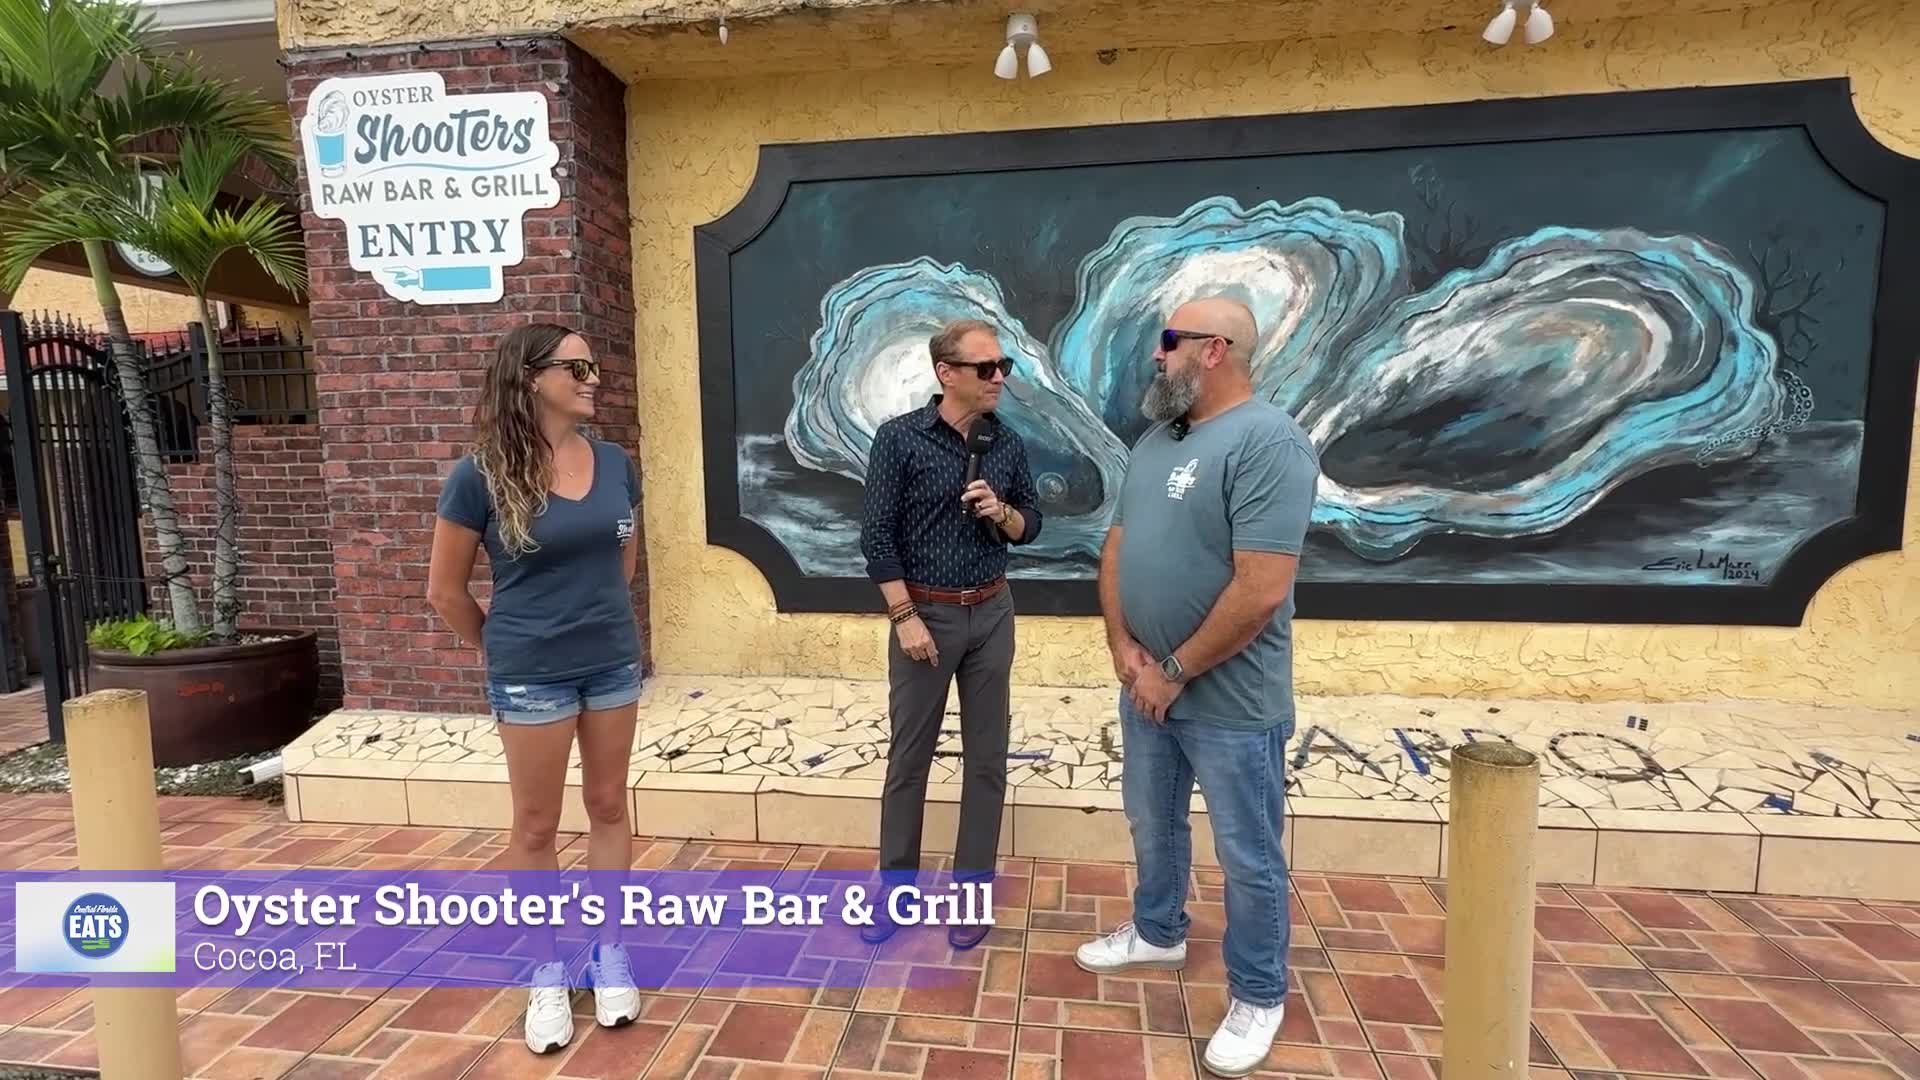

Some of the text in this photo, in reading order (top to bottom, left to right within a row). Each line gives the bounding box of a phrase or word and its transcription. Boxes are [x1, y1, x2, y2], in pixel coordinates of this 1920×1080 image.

[353, 85, 434, 108] OYSTER
[354, 109, 535, 164] Shooters
[322, 173, 549, 205] RAW BAR & GRILL
[357, 218, 510, 258] ENTRY
[1642, 557, 1692, 571] Eric
[1727, 569, 1760, 581] 2024
